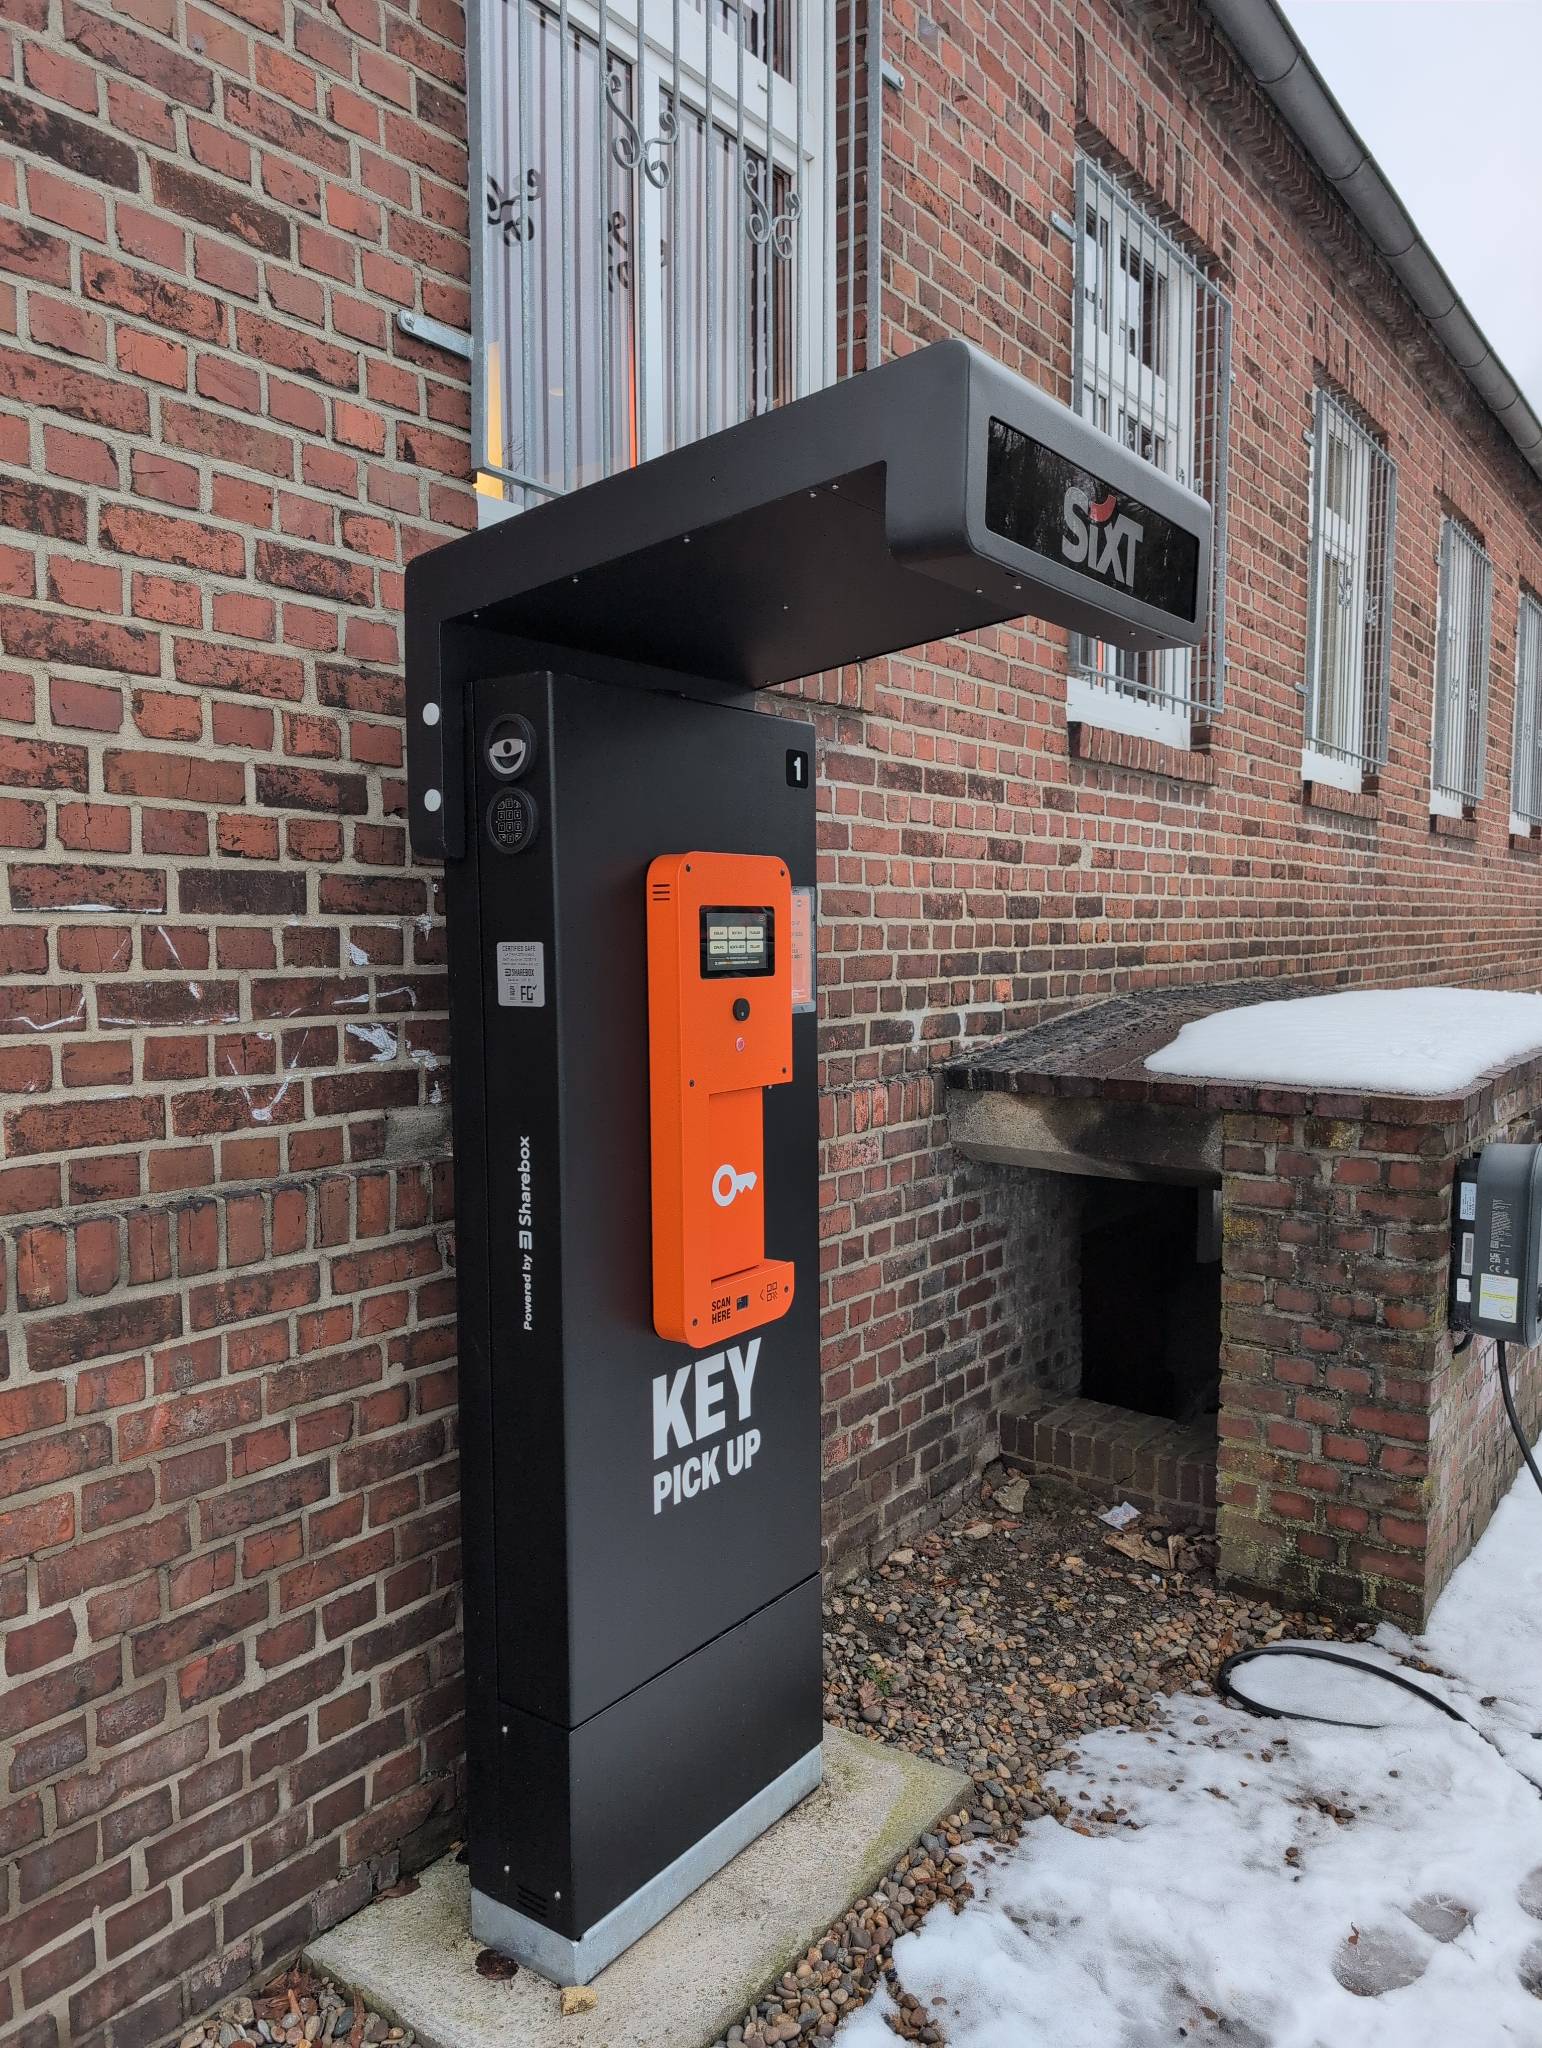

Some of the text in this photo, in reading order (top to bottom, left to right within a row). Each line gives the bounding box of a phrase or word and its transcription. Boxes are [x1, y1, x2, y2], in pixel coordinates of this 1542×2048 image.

[793, 756, 802, 781] 1
[517, 1135, 533, 1331] Powered by Sharebox
[711, 1295, 731, 1312] SCAN
[711, 1308, 731, 1325] HERE
[652, 1336, 762, 1461] KEY
[653, 1428, 762, 1516] PICK UP
